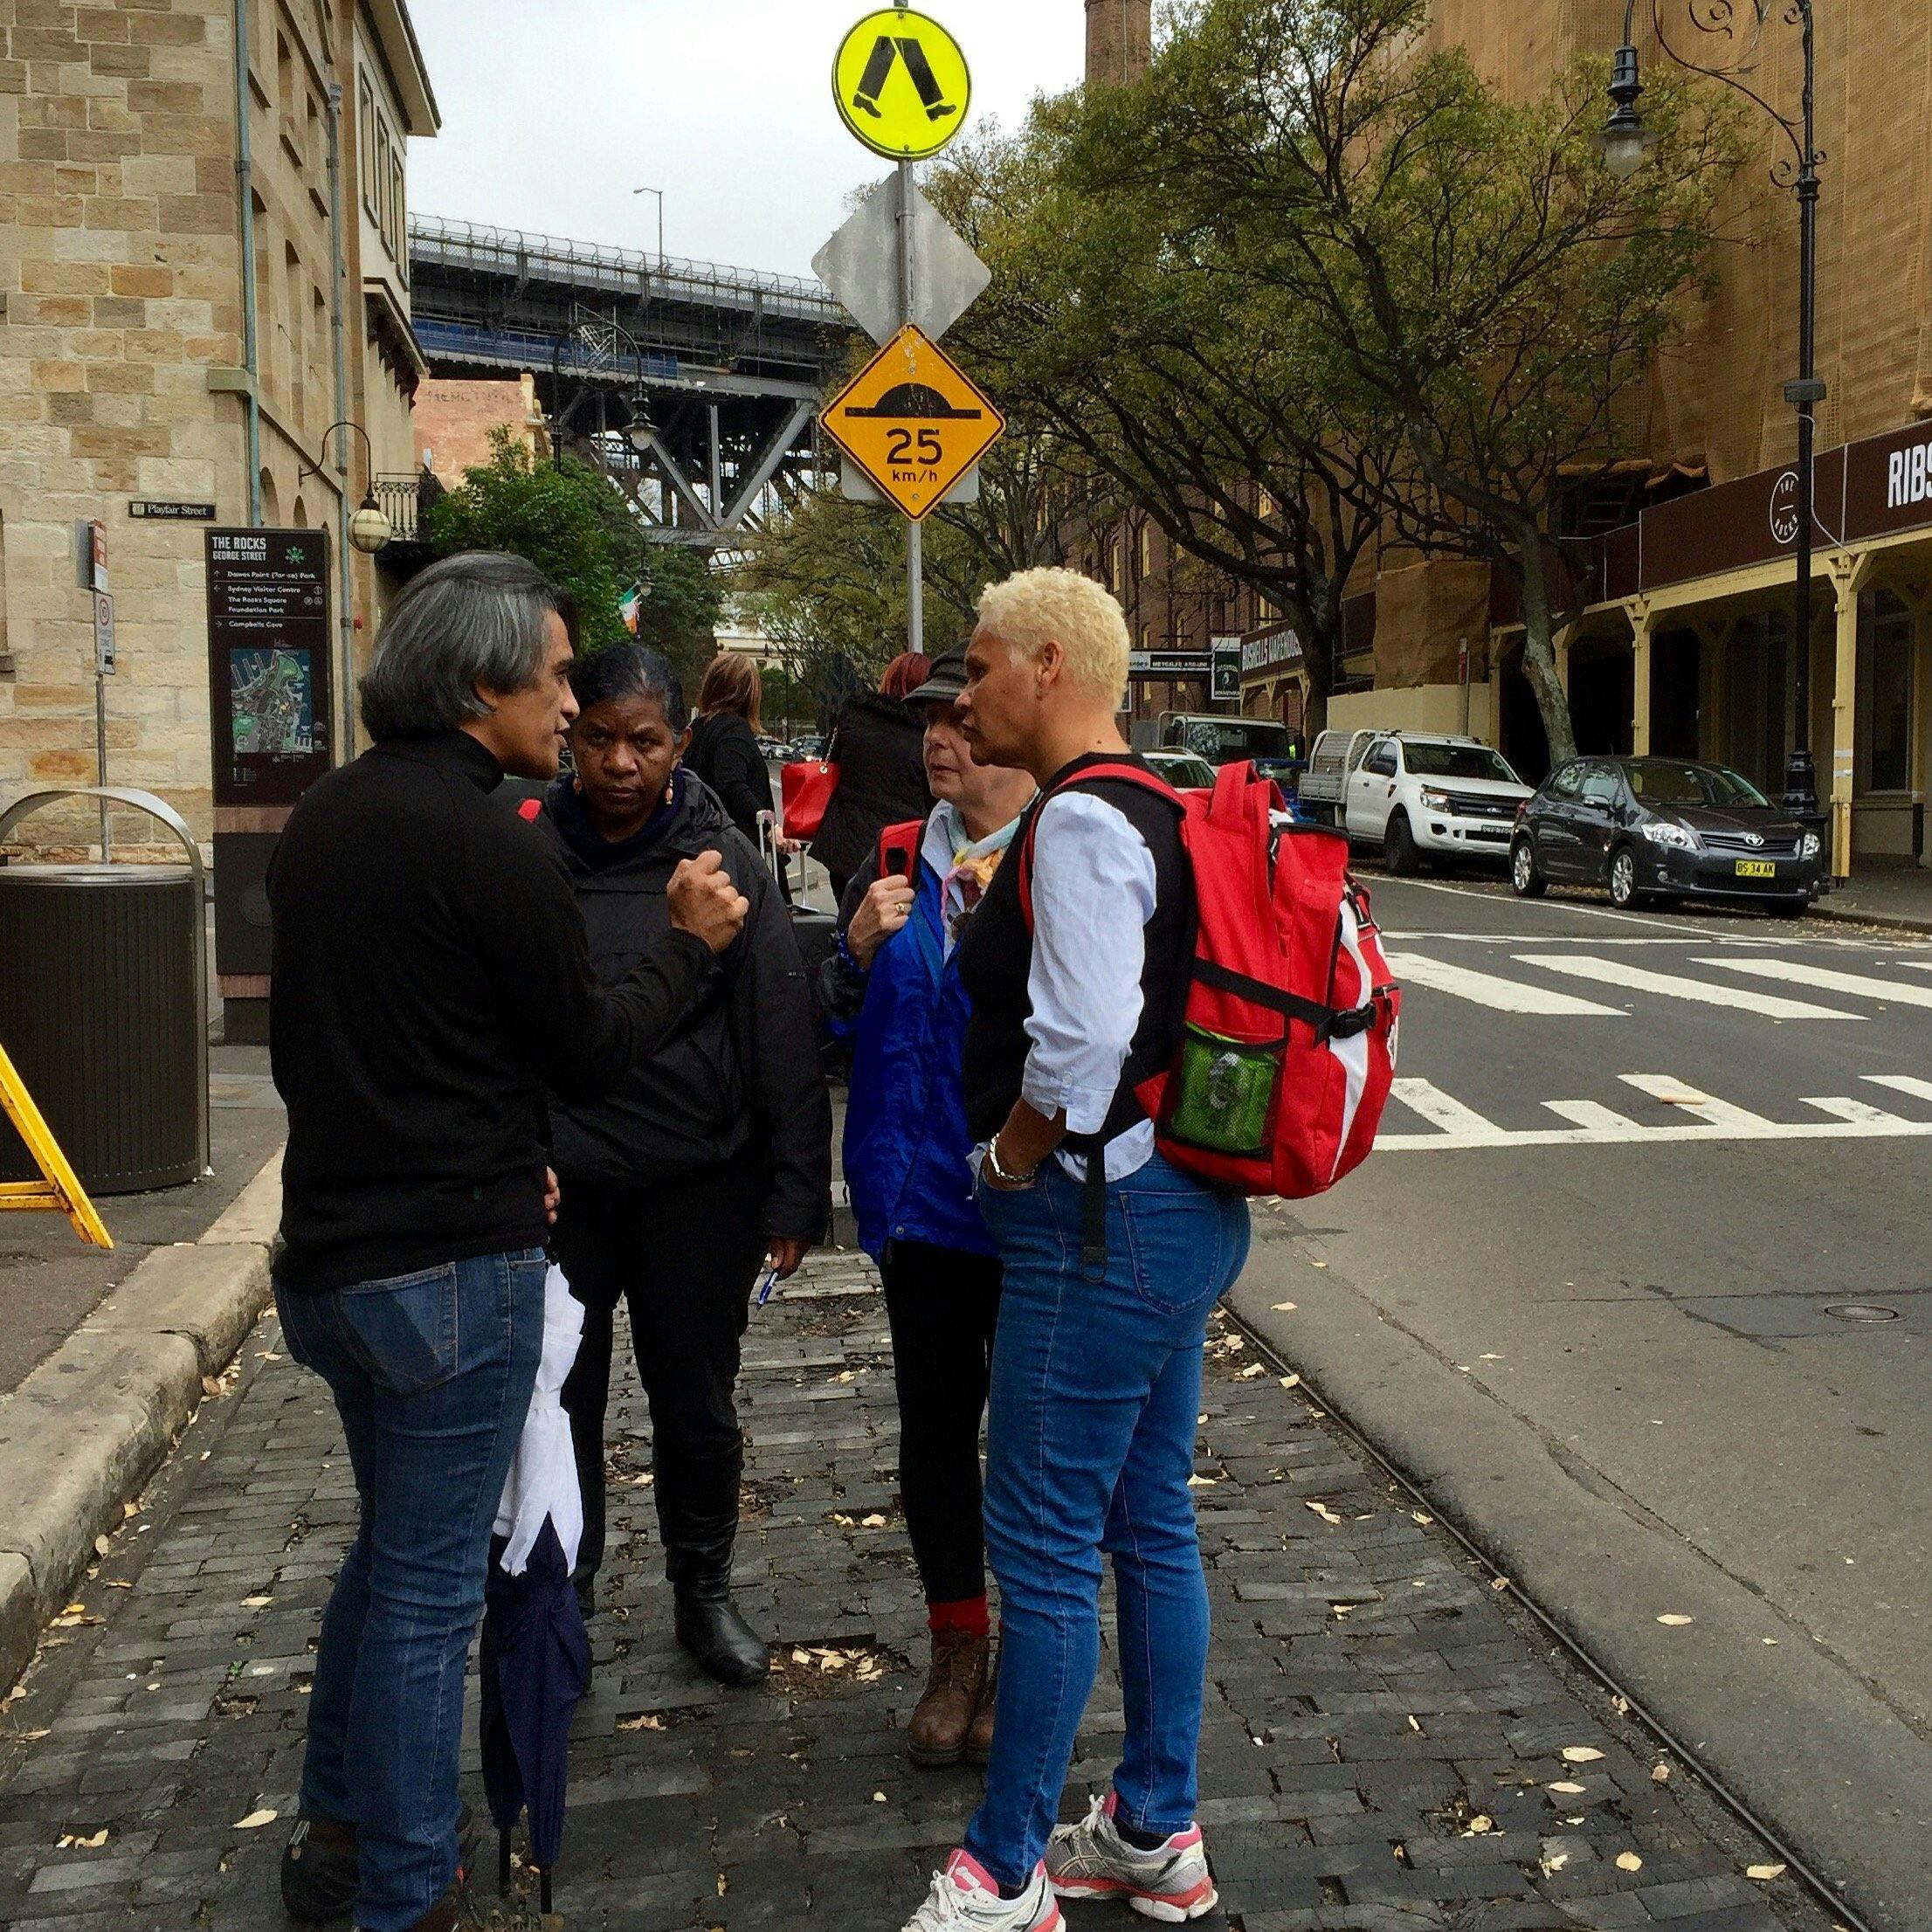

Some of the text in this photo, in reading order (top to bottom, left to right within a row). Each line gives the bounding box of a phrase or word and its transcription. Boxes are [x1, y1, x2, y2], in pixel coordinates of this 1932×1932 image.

[886, 428, 942, 466] 25
[892, 469, 938, 483] km/h
[1780, 480, 1795, 494] THE
[148, 504, 207, 515] Playfair Street
[1774, 514, 1797, 536] ROCKS
[212, 536, 267, 550] THE ROCKS
[212, 550, 267, 561] GEORGE STREET
[227, 585, 252, 594] Sydney
